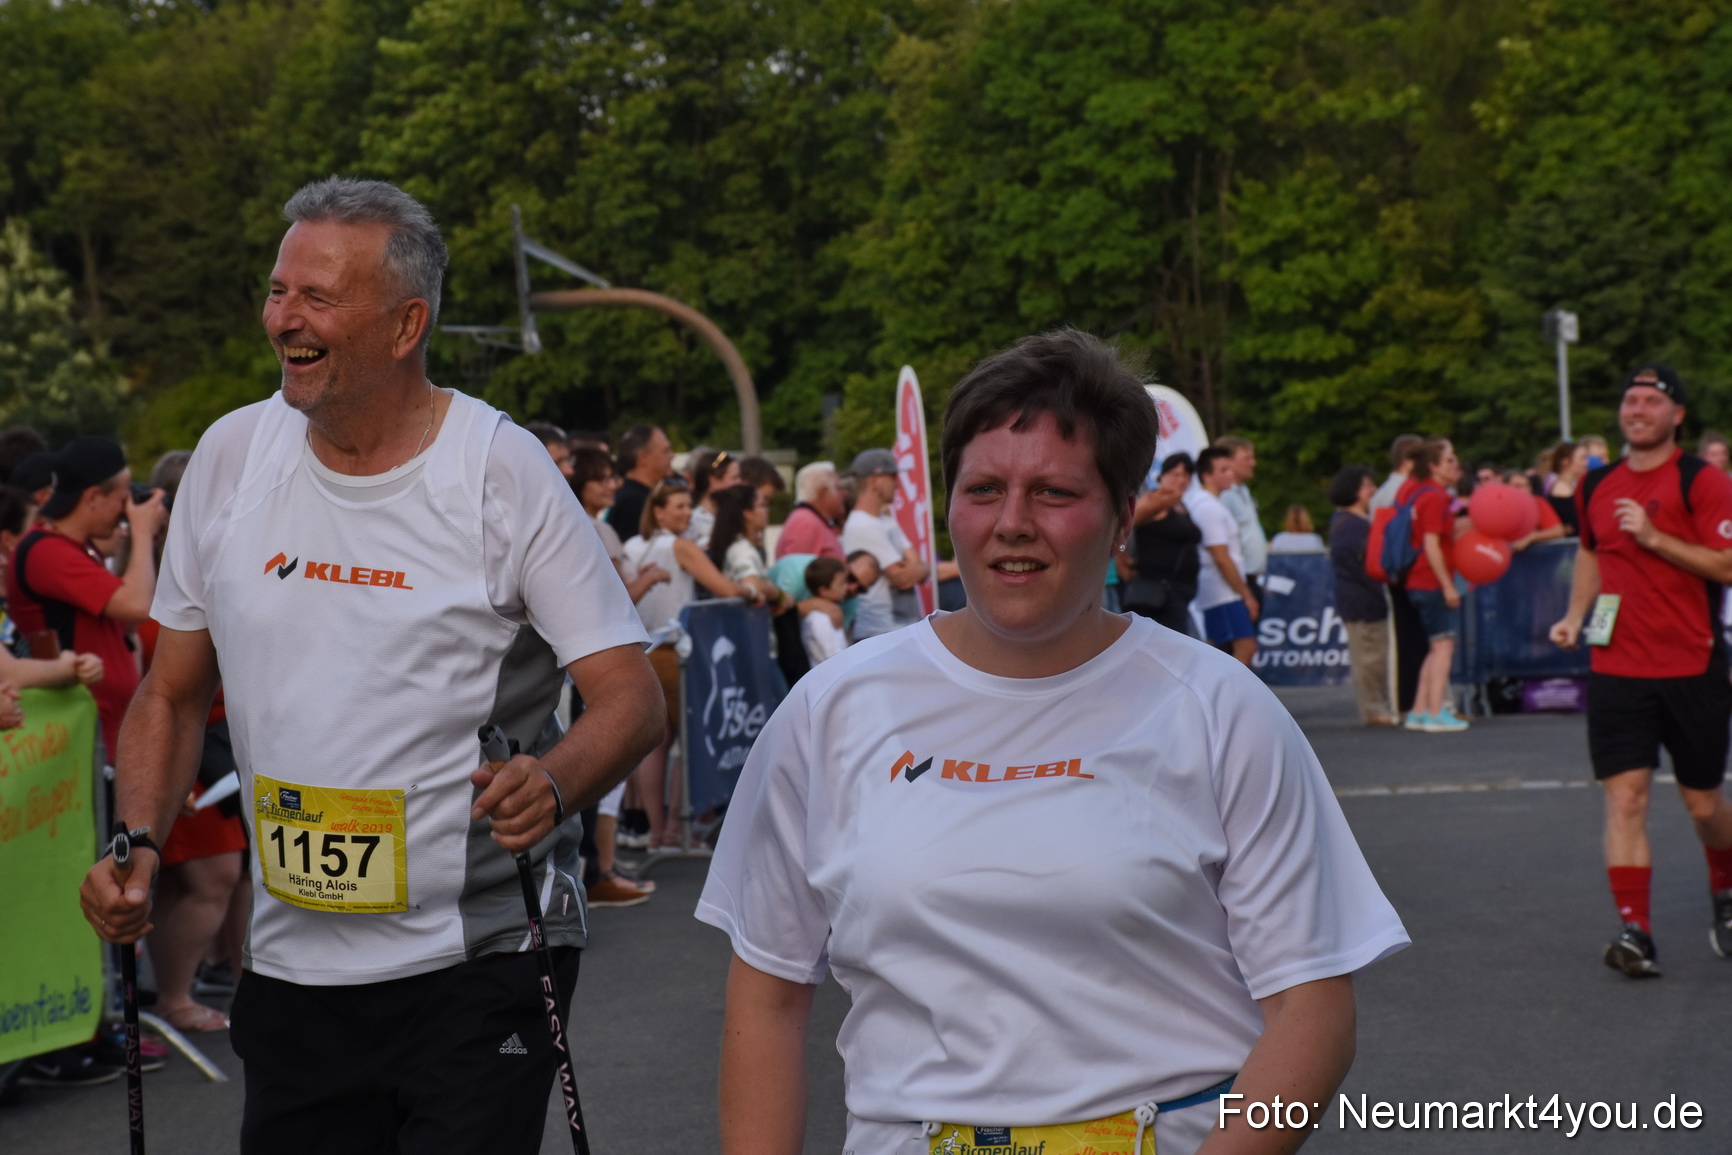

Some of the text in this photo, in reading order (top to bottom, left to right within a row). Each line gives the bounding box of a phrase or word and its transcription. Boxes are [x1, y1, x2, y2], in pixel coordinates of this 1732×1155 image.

[304, 561, 413, 590] KLEBL
[1257, 606, 1349, 646] sch
[941, 758, 1095, 783] KLEBL
[271, 802, 324, 823] firmenlauf
[331, 819, 392, 833] walk 2019
[271, 825, 380, 878] 1157
[289, 873, 357, 891] Häring Alois
[299, 888, 316, 898] Klebl
[318, 892, 344, 900] GmbH
[125, 1023, 140, 1077] EASY
[499, 1046, 527, 1055] adidas
[540, 975, 580, 1131] EASY WAY
